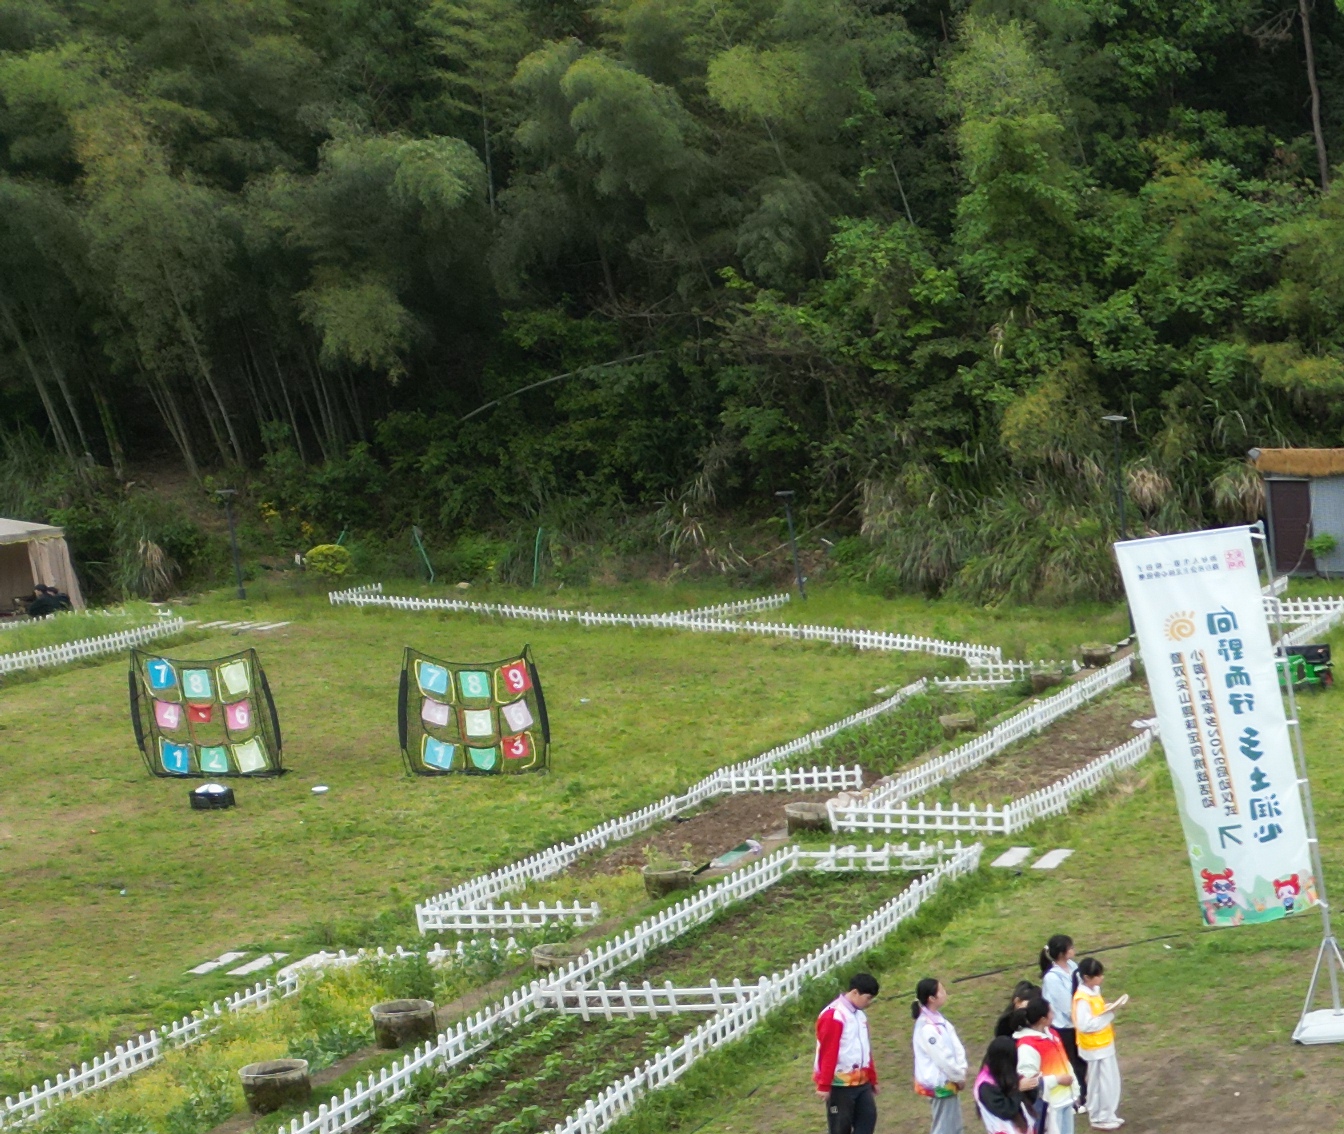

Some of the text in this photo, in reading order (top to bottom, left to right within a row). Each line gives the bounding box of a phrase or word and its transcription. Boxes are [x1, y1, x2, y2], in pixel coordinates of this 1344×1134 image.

[155, 664, 203, 693] 7 8
[427, 667, 524, 694] 7 8 9
[163, 705, 247, 724] 4 6
[510, 737, 524, 755] 3
[173, 749, 182, 768] 1
